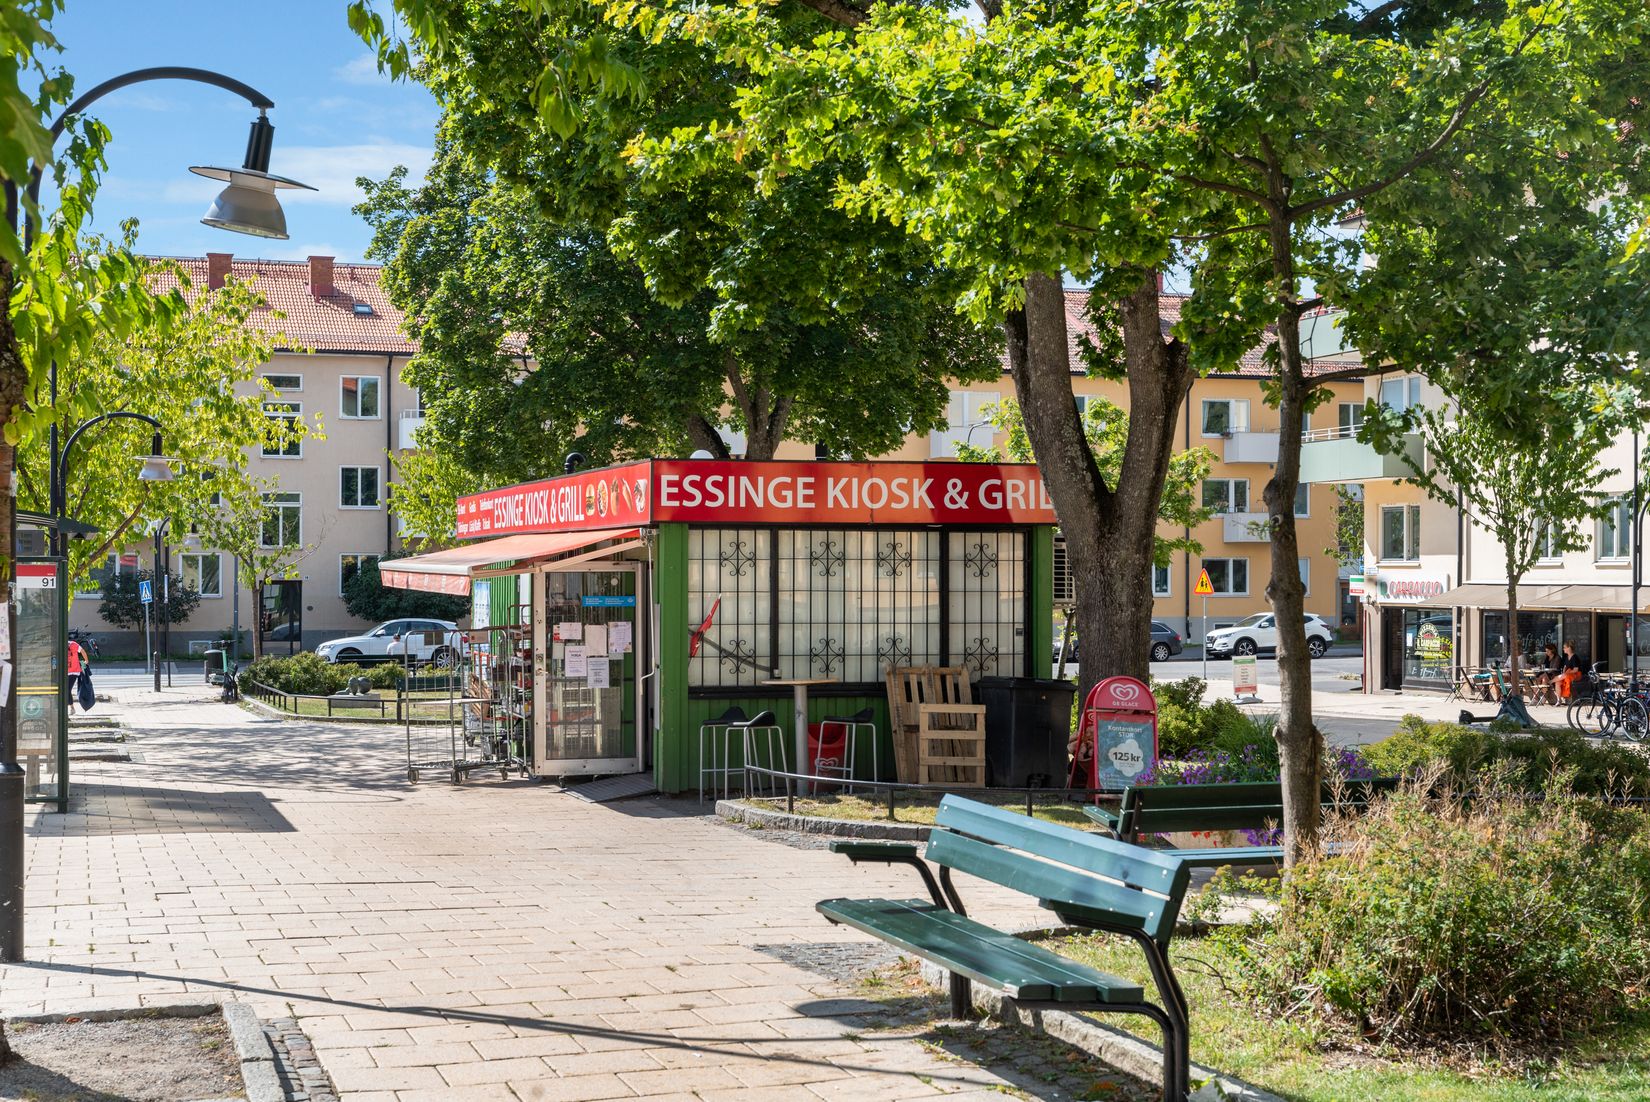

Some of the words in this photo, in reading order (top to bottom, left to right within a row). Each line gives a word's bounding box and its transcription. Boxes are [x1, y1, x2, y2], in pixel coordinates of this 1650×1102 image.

[660, 474, 816, 509] ESSINGE
[827, 477, 935, 510] KIOSK
[943, 478, 969, 510] &
[494, 494, 524, 528] ESSINGE
[525, 489, 549, 526] KIOSK
[550, 488, 557, 524] &
[558, 484, 585, 523] GRILL
[42, 577, 55, 587] 91
[1108, 725, 1143, 733] Kontantkort
[1113, 752, 1130, 761] 125
[1131, 753, 1141, 762] kr
